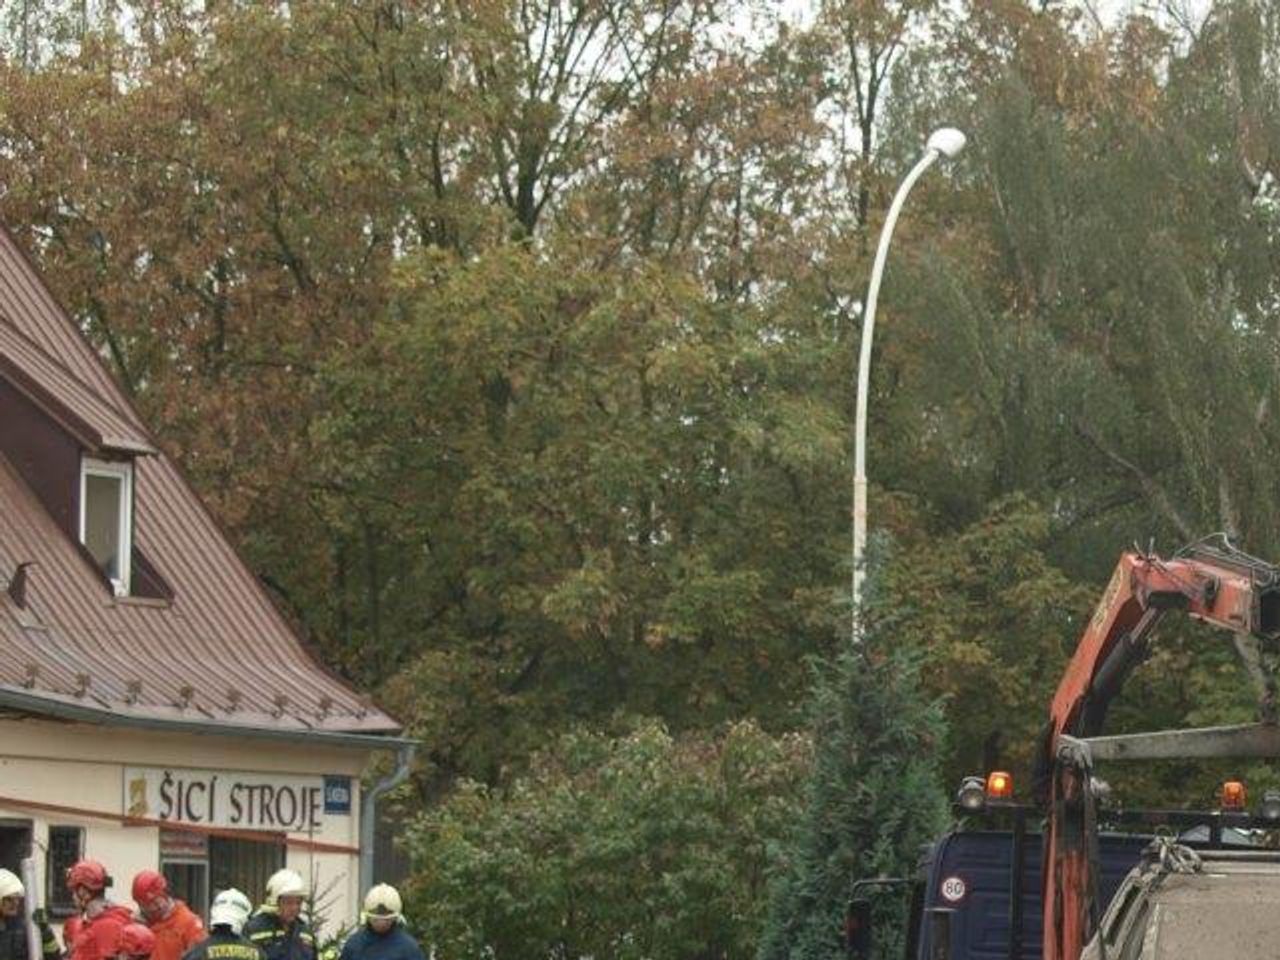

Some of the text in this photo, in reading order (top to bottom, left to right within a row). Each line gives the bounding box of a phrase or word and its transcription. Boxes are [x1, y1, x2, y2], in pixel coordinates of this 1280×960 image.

[159, 770, 323, 830] ŠICÍ STROJE
[945, 881, 963, 896] 80
